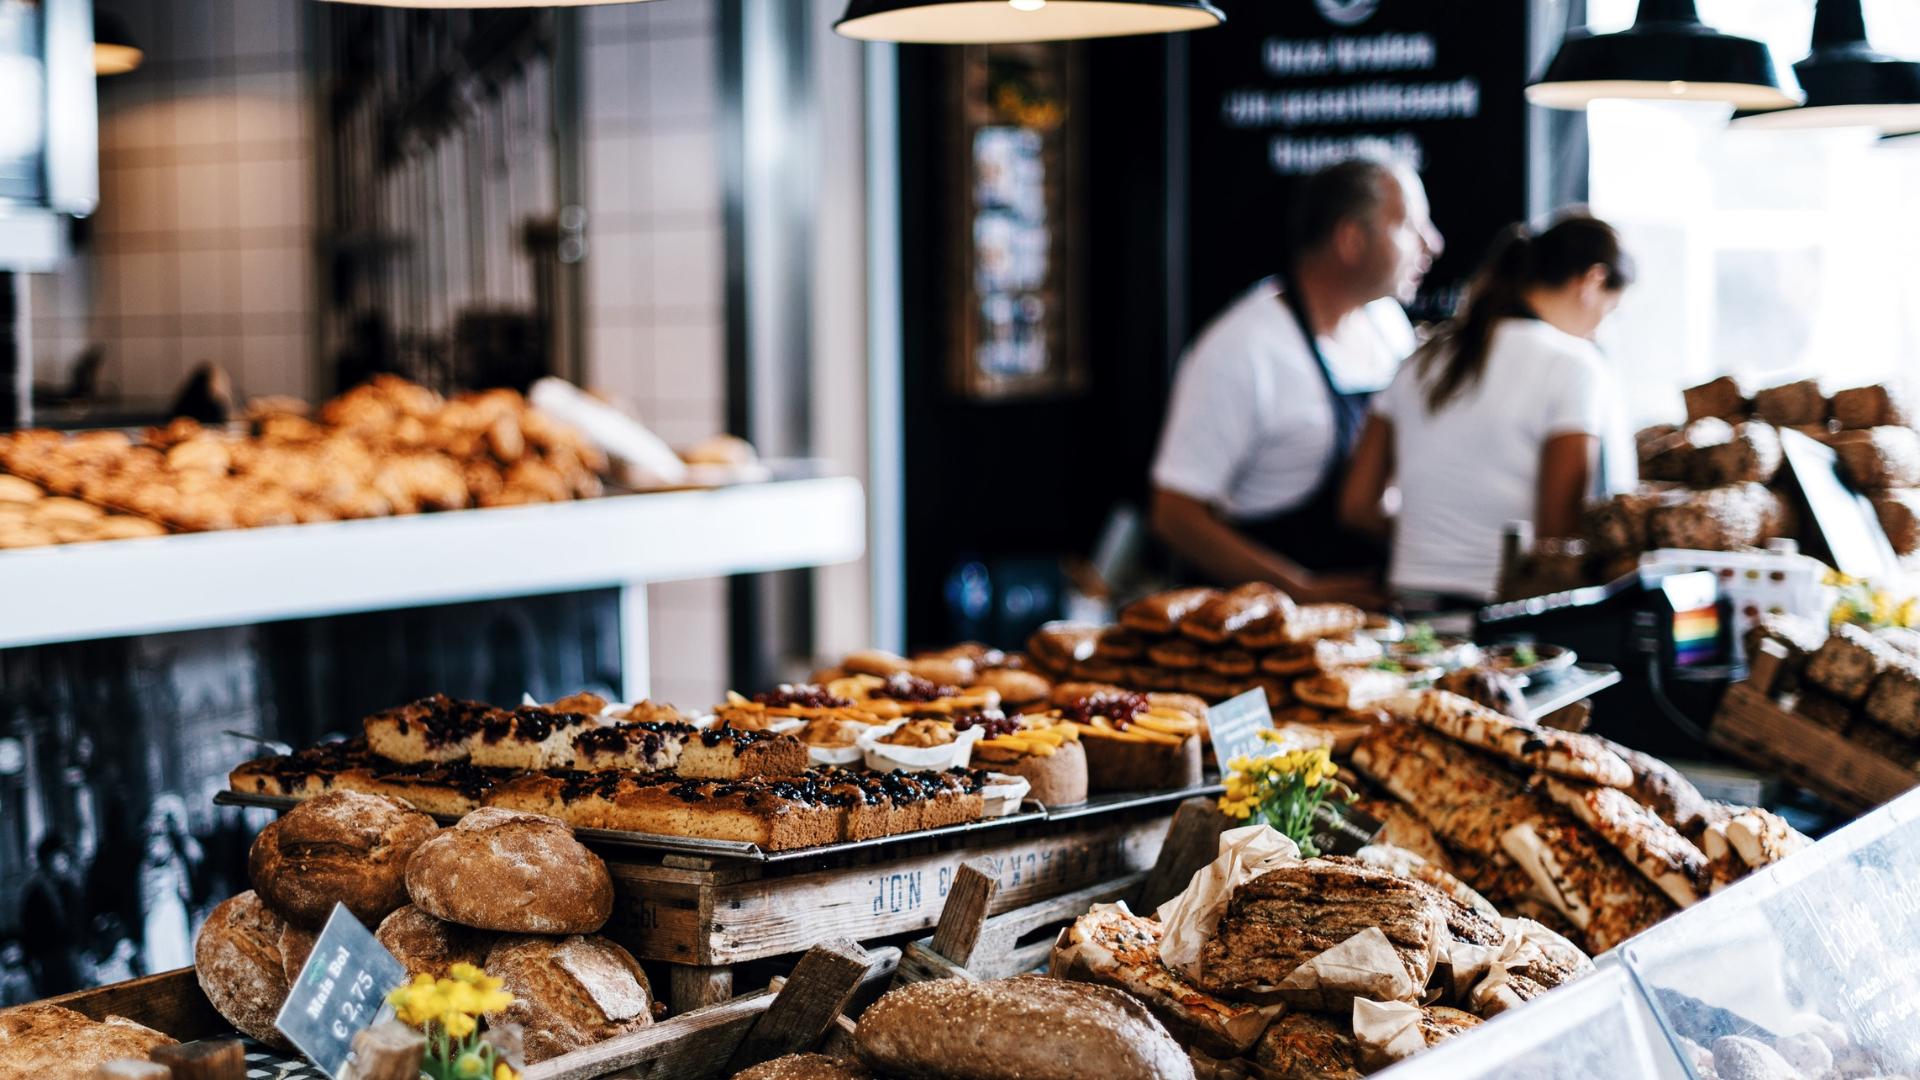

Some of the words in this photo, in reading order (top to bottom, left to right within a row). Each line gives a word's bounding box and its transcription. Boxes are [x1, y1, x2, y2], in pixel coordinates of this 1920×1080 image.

[307, 980, 335, 1019] Mais
[329, 946, 350, 977] Bol
[333, 1020, 348, 1039] €
[343, 971, 373, 1021] 2,75
